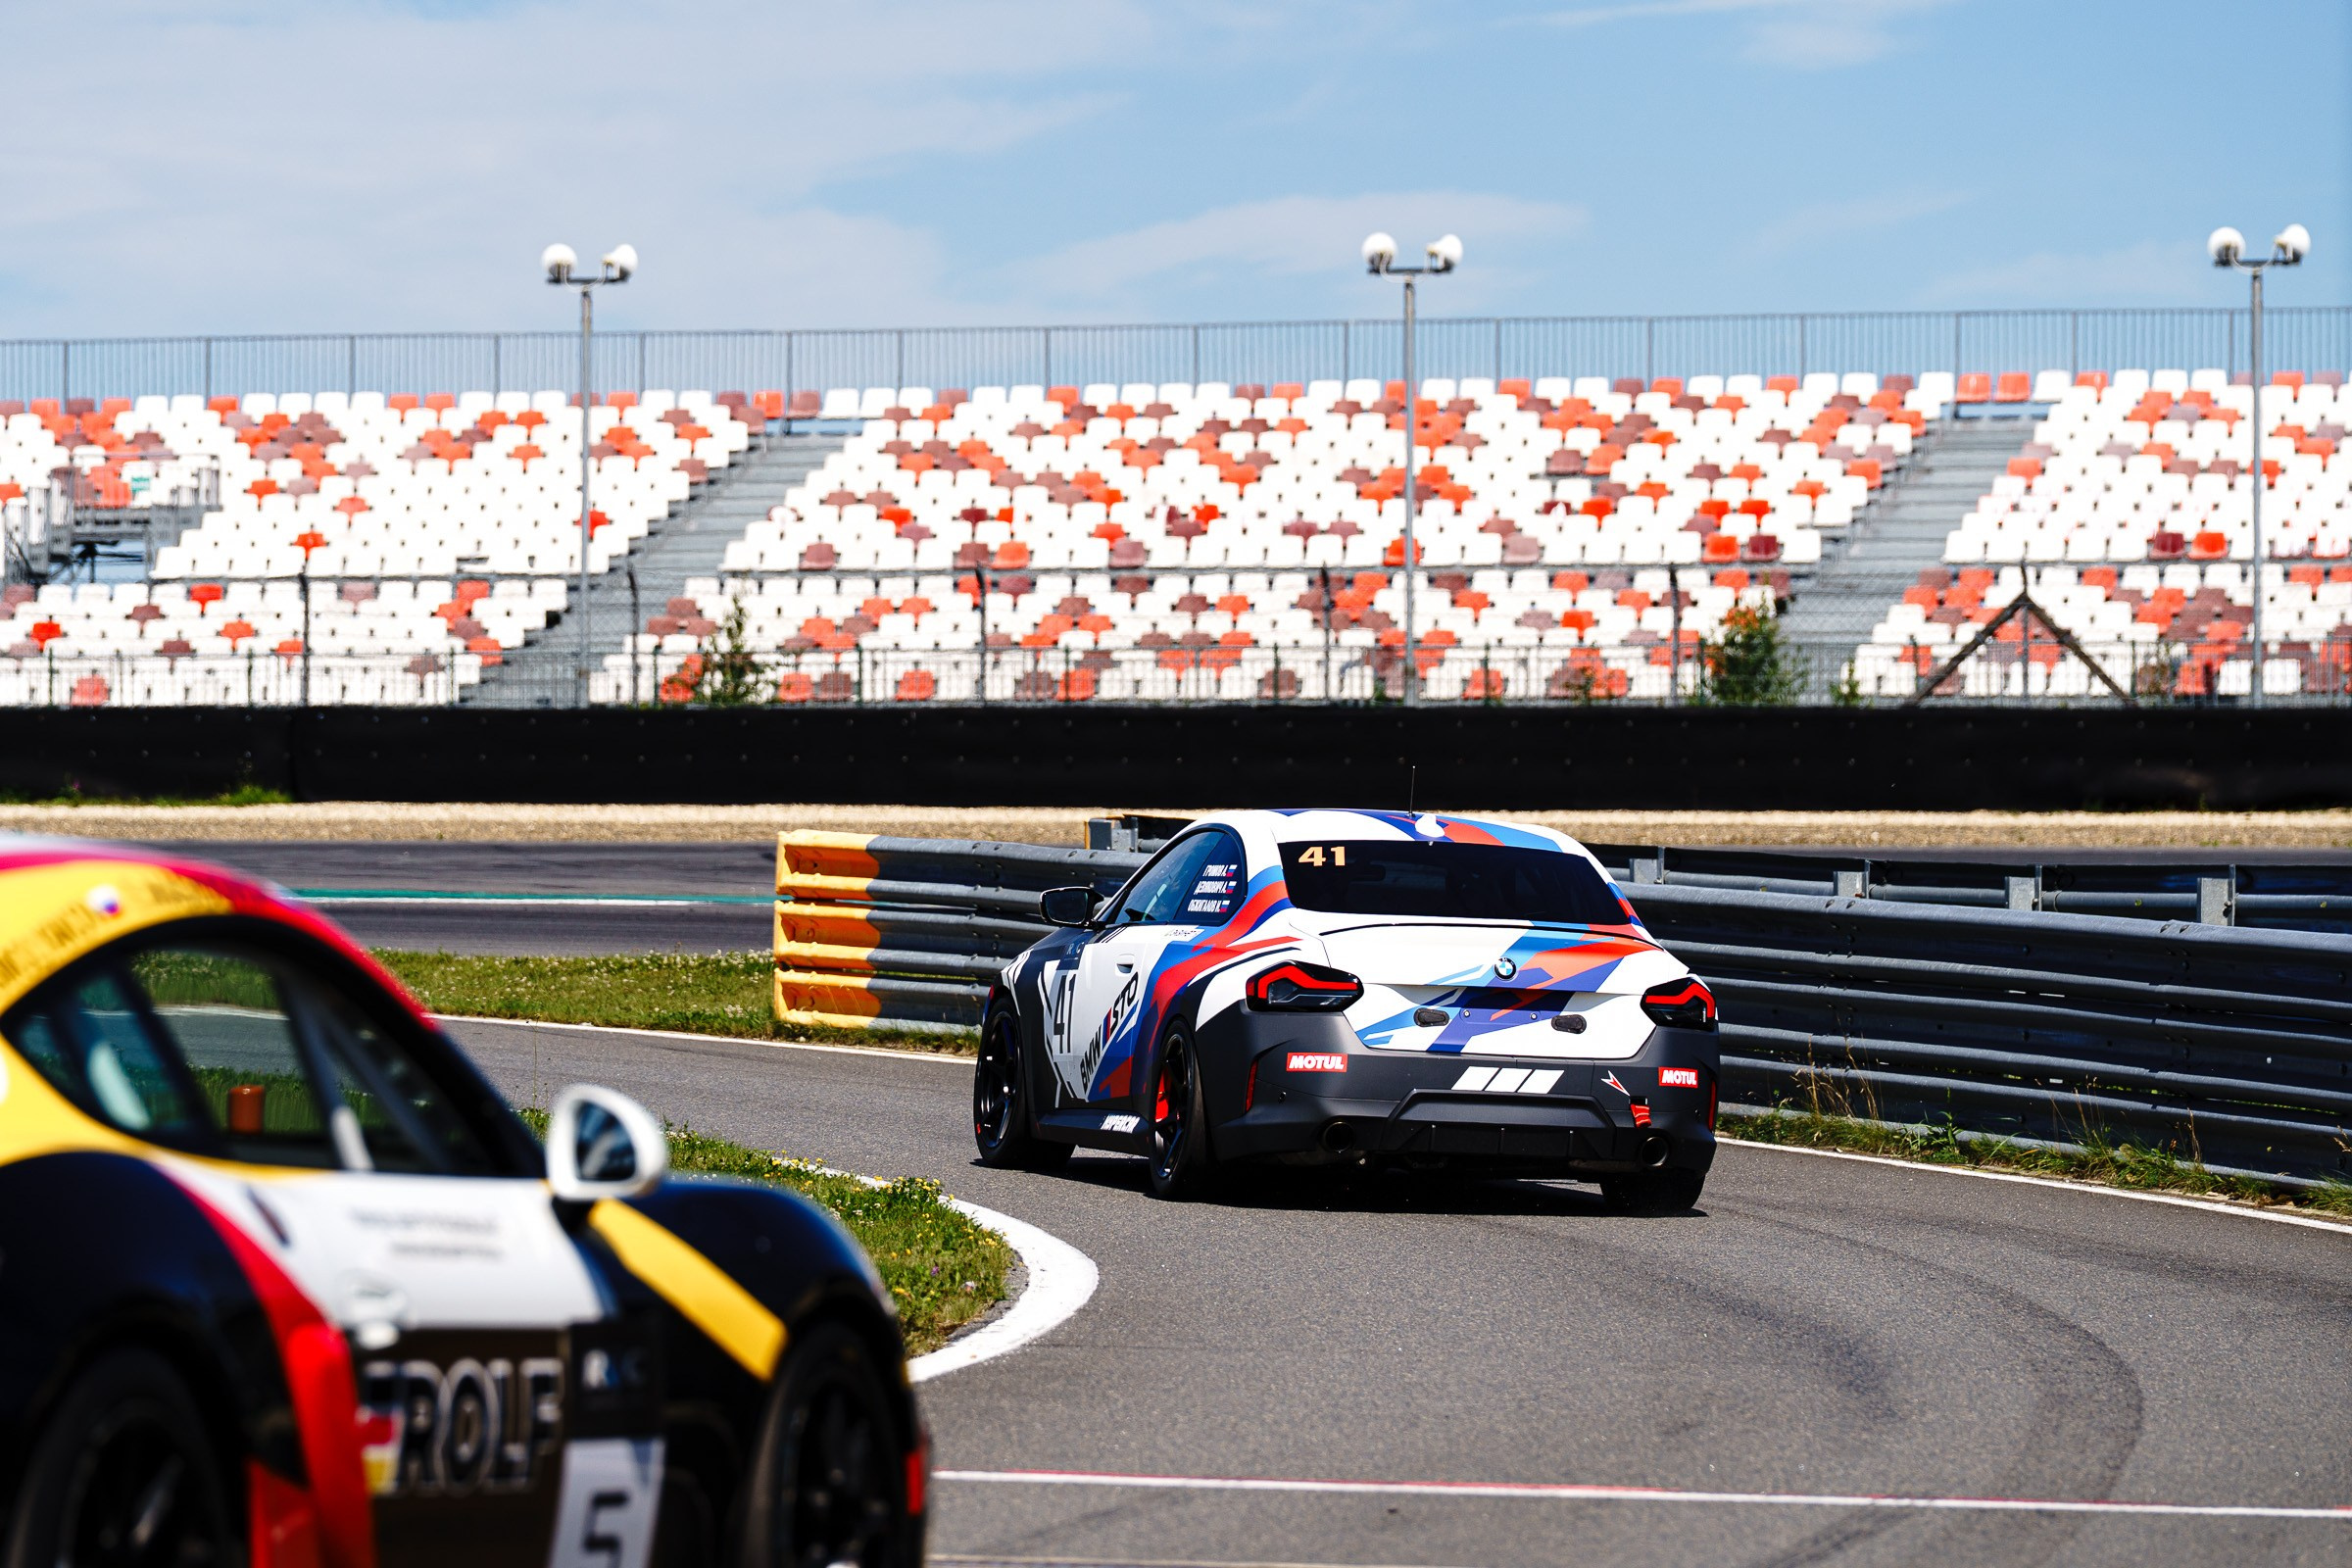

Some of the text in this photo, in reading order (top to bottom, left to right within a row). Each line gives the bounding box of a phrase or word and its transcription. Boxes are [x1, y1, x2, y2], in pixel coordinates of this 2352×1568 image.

[1298, 846, 1346, 867] 41
[1054, 973, 1077, 1054] 41
[1080, 971, 1139, 1095] BMW STO
[1288, 1054, 1346, 1070] MOTUL
[1661, 1069, 1697, 1085] MOTUL
[394, 1357, 564, 1496] ROLF
